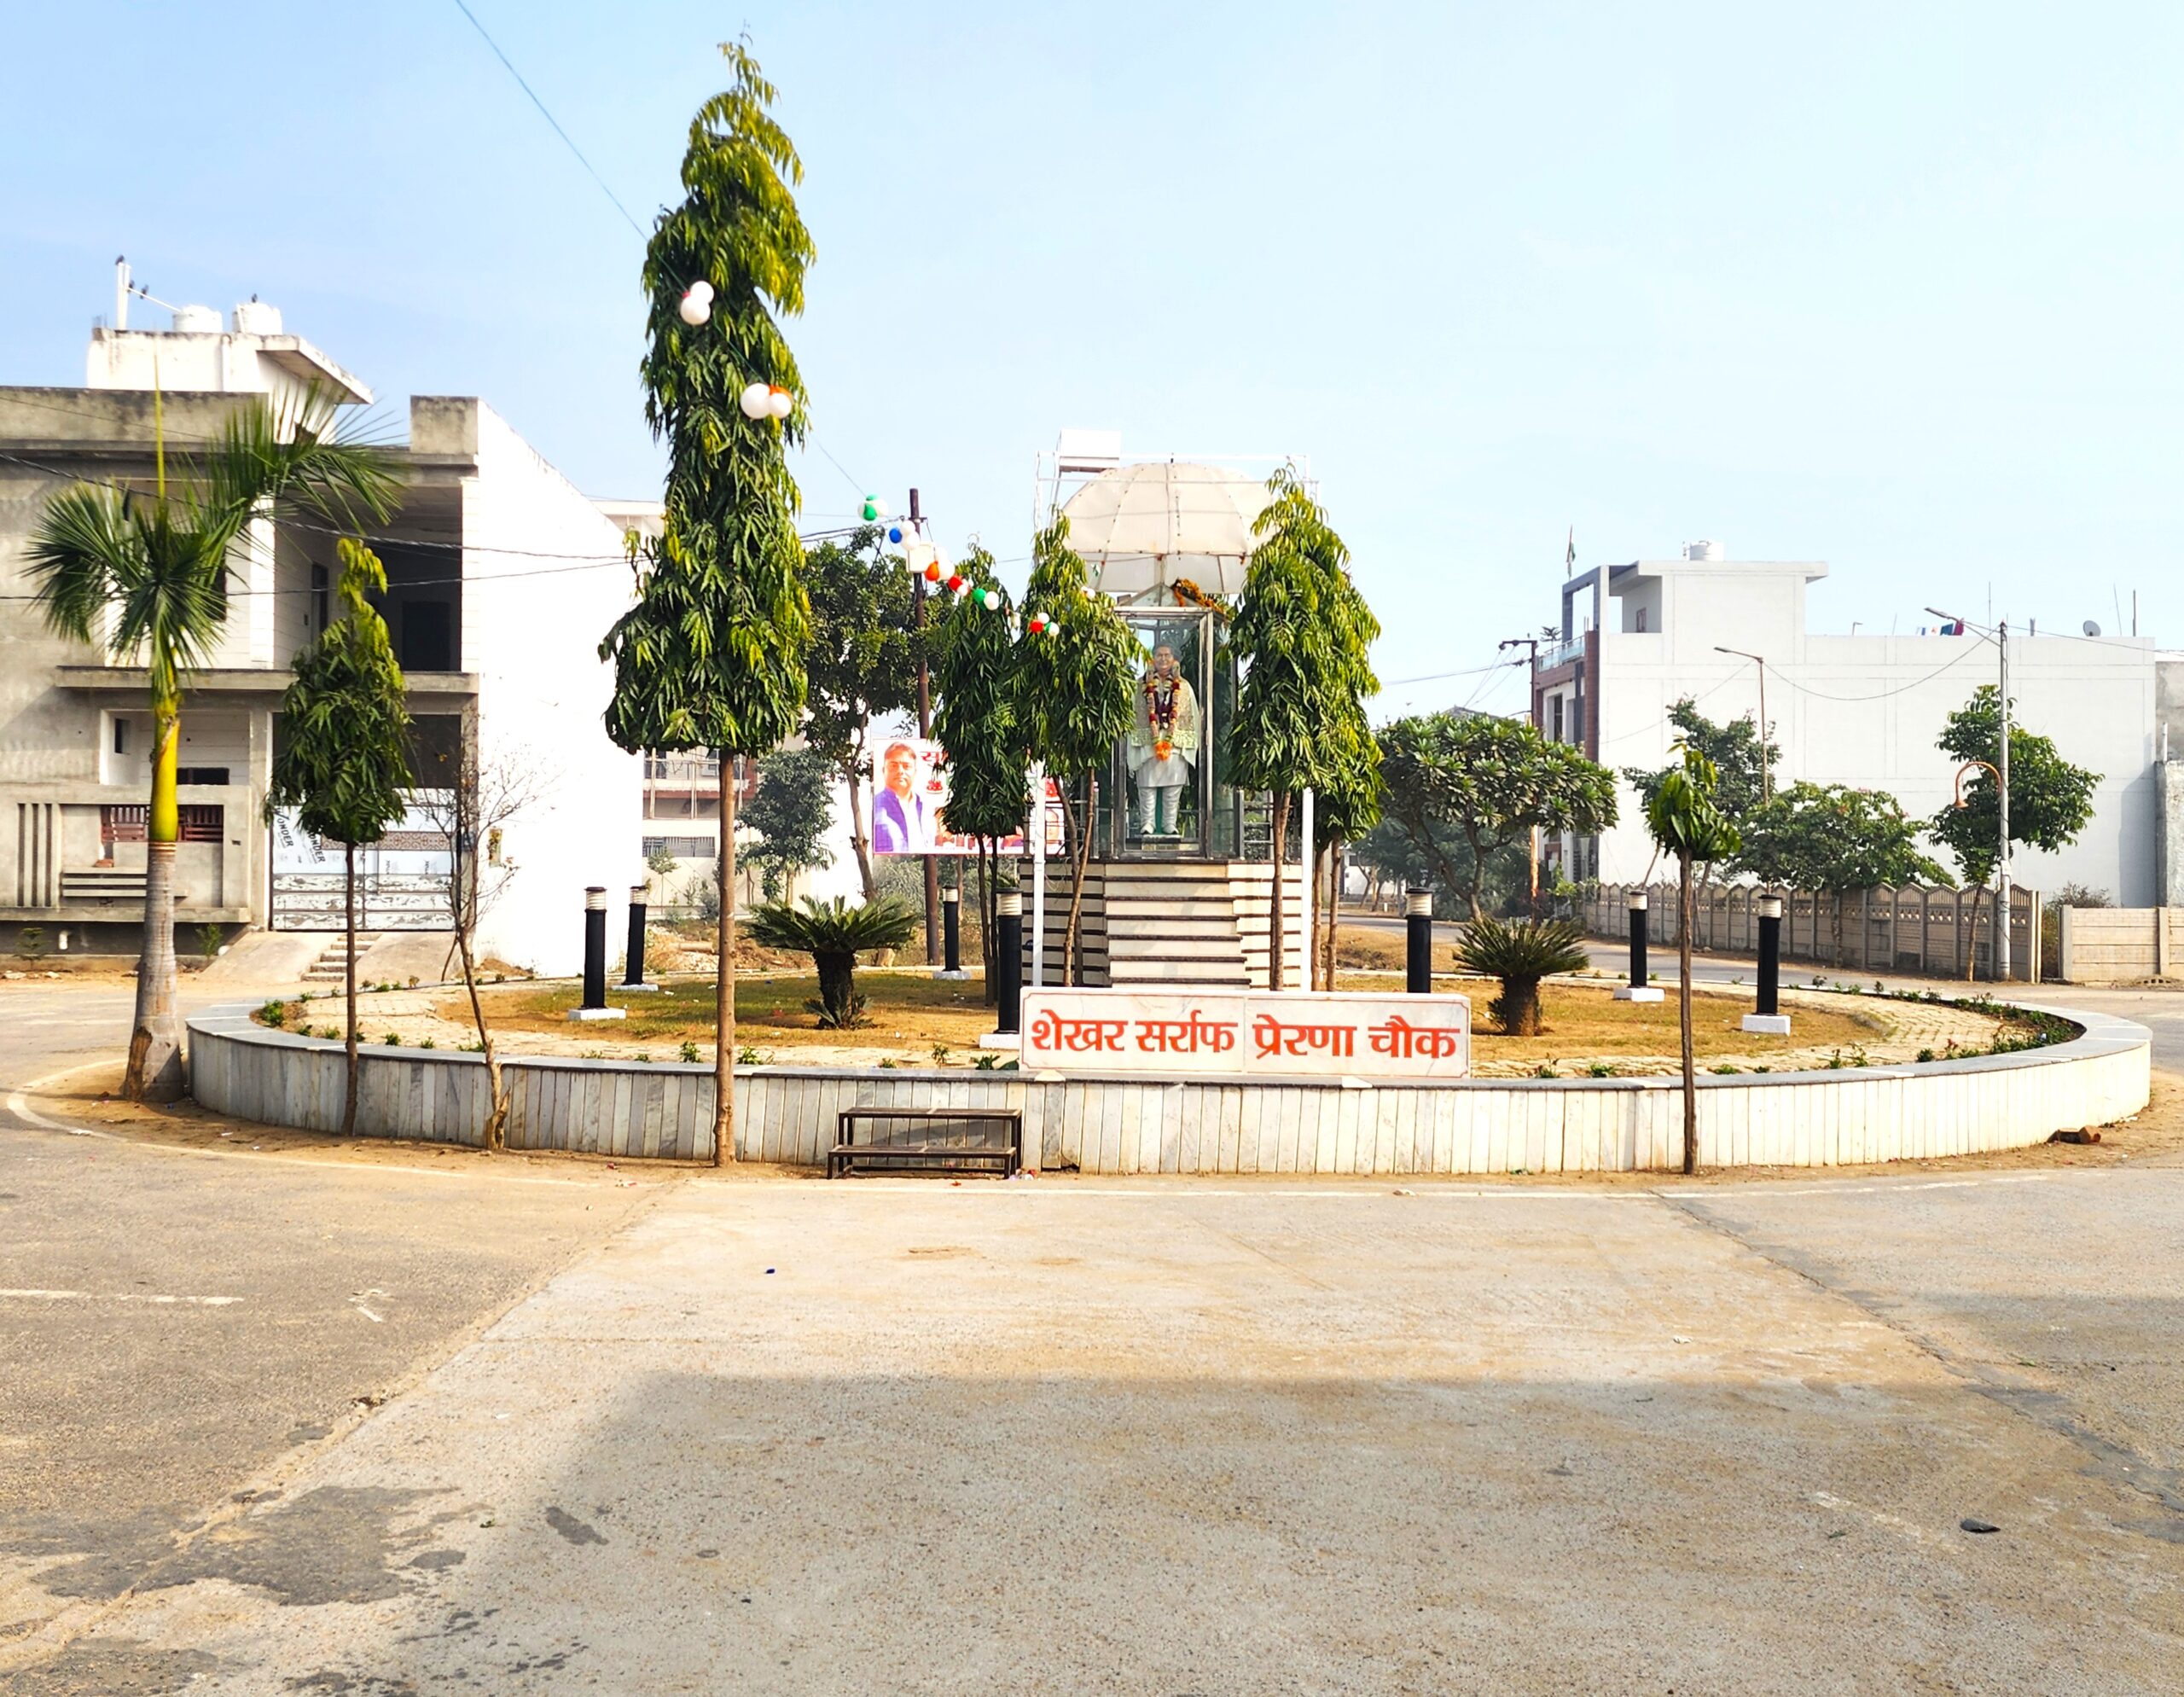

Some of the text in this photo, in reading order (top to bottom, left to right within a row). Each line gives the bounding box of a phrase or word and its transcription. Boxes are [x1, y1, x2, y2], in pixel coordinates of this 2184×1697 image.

[307, 830, 326, 863] ONDER
[1031, 1008, 1461, 1060] शेखर सर्राफ प्रेरणा चौक
